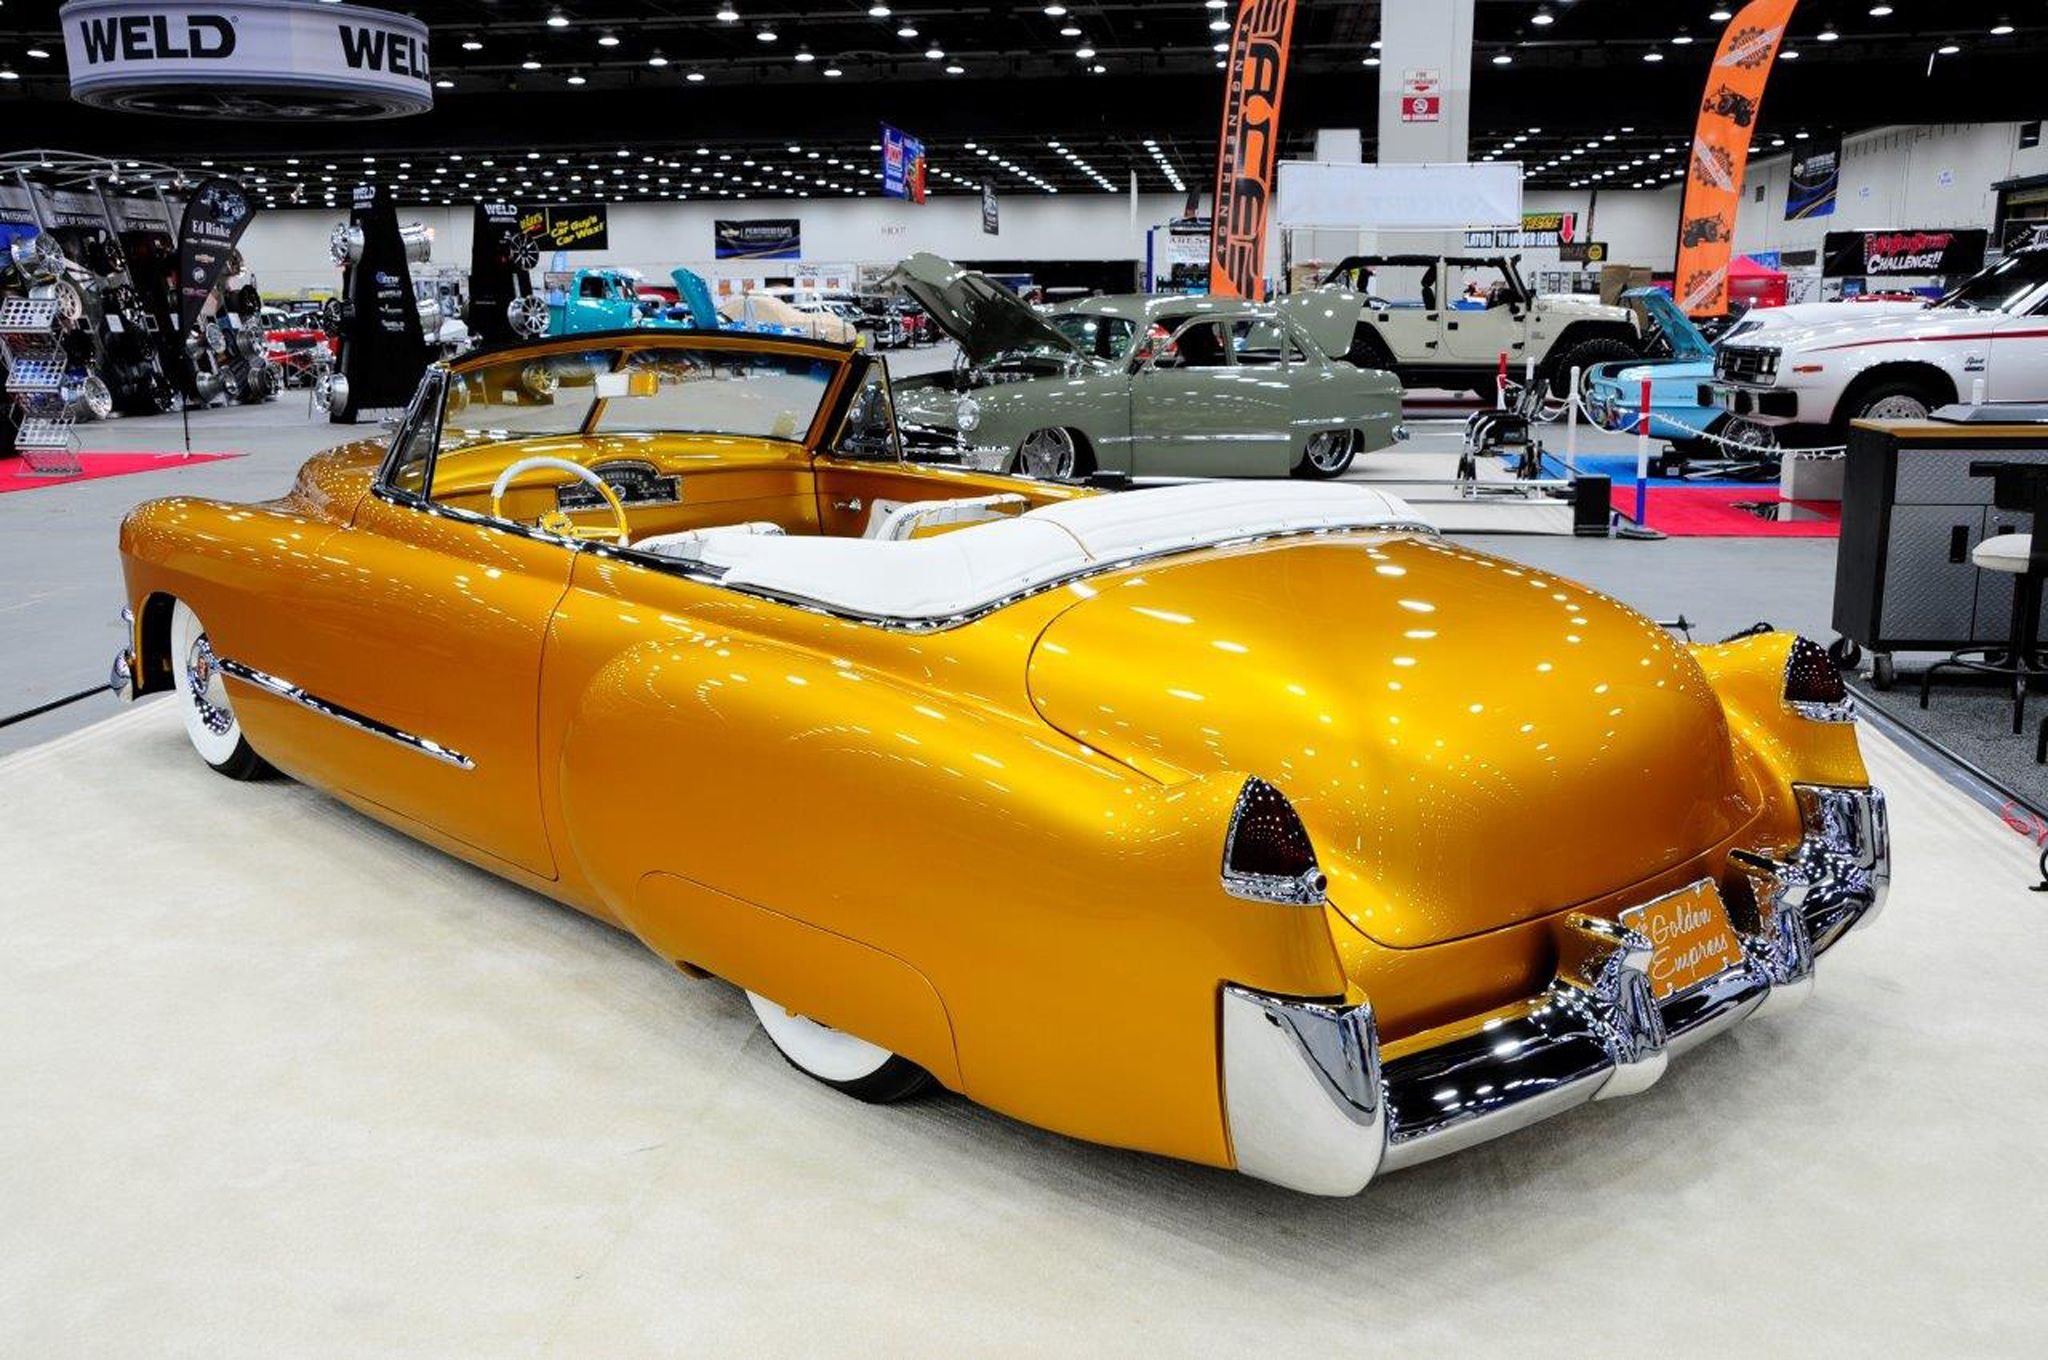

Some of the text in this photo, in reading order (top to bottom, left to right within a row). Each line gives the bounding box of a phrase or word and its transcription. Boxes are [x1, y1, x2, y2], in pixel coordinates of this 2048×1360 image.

[80, 15, 236, 64] WELD
[1218, 41, 1246, 236] ENGINEERING
[1232, 42, 1281, 236] ACE
[353, 186, 376, 200] WELD
[484, 203, 517, 215] WELD
[192, 220, 231, 237] Ed Rinke
[551, 226, 569, 238] Car
[1537, 231, 1558, 246] LEVEL
[556, 234, 575, 246] Car
[1867, 251, 1944, 274] CHALLENGE!!
[1652, 902, 1712, 944] Golden
[1652, 933, 1729, 979] Empress
